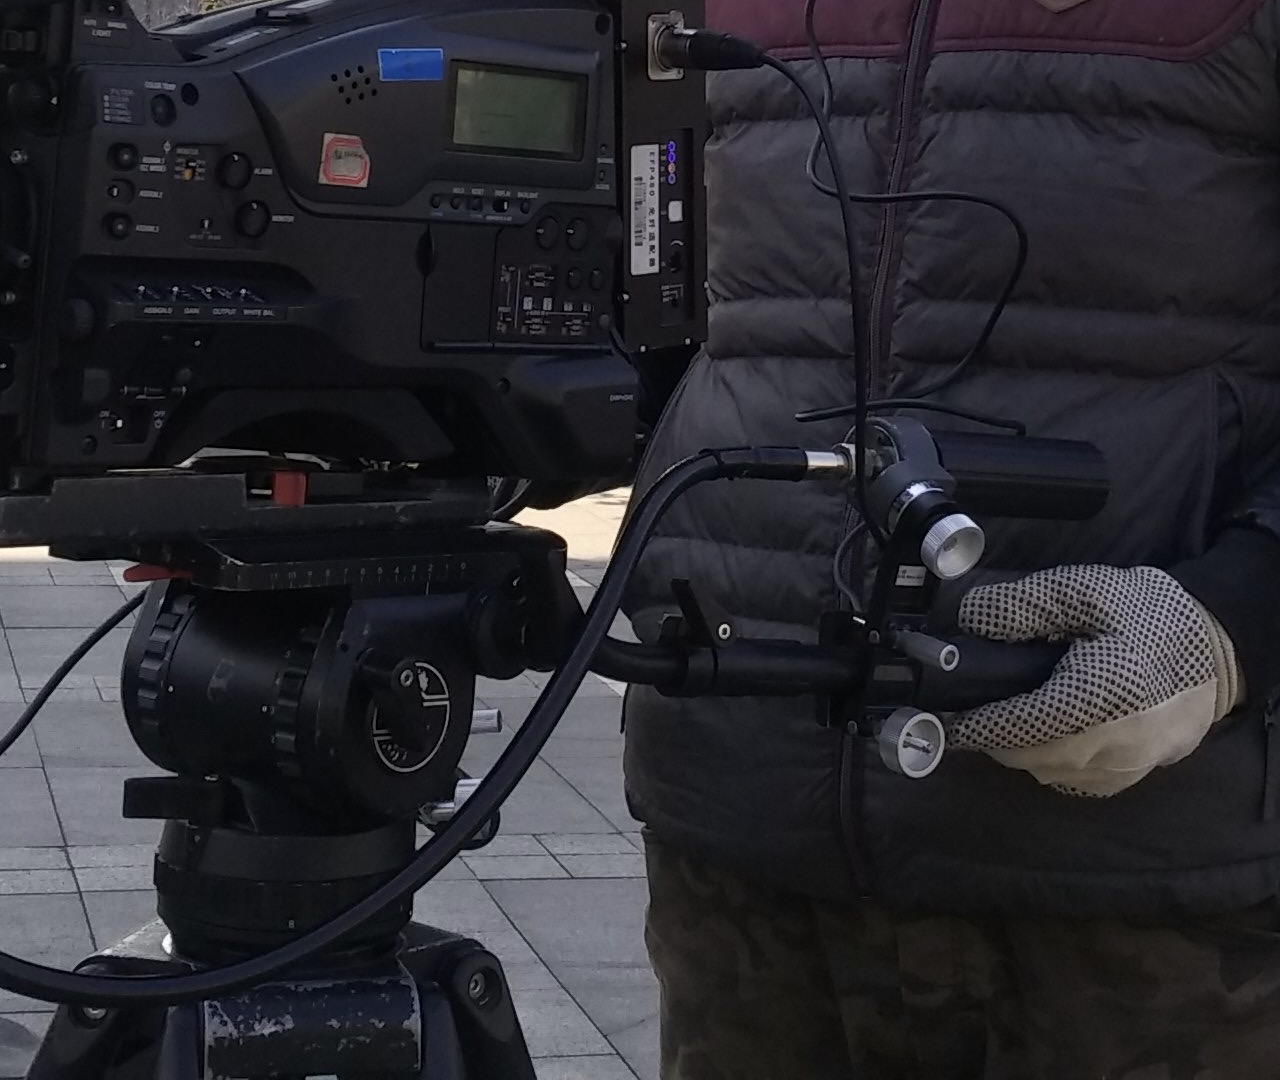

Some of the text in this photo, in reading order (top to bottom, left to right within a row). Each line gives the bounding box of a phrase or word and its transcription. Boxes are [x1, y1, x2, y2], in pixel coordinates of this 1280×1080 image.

[212, 307, 237, 315] OUTPUT
[243, 308, 262, 316] WHITE
[100, 410, 110, 418] ON
